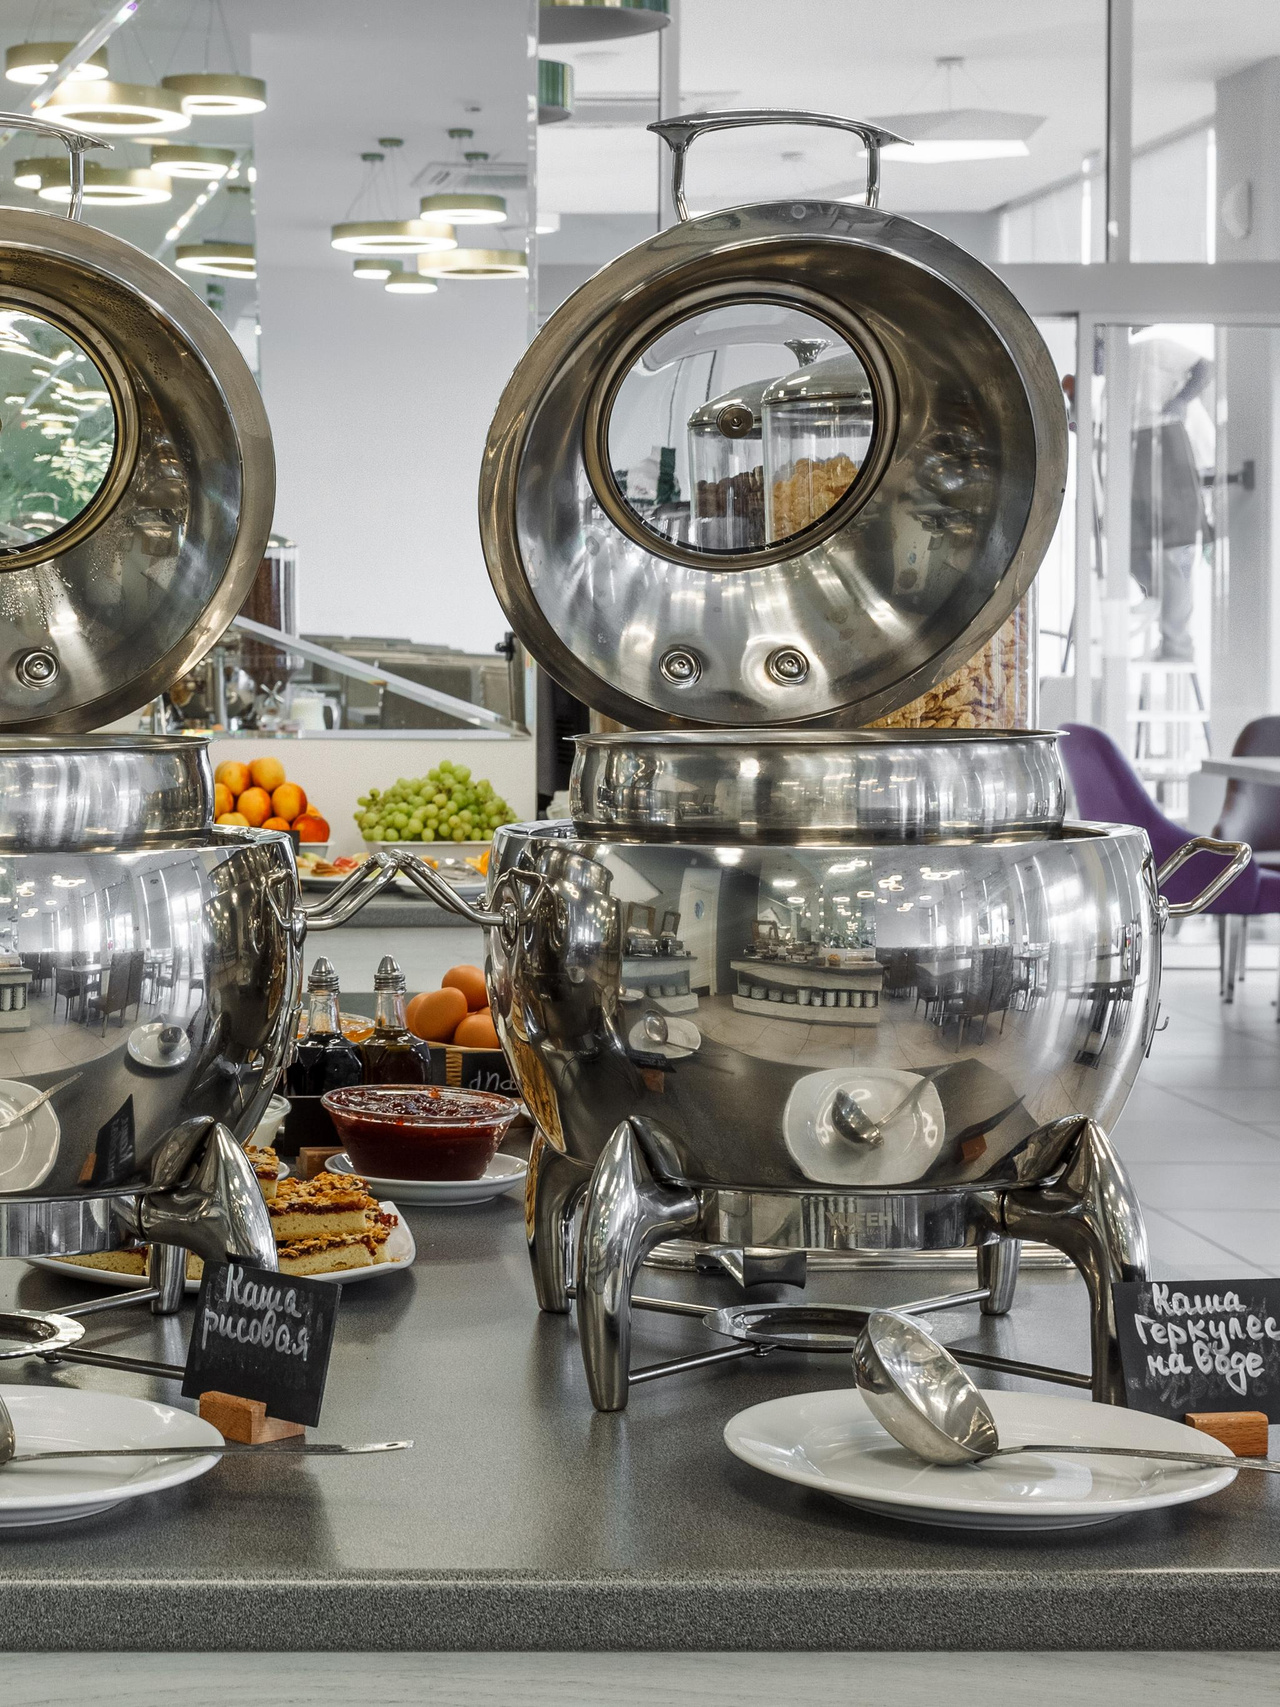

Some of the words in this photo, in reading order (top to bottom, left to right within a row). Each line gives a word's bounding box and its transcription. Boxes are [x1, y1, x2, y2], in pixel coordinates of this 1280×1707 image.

[225, 1263, 302, 1318] Каша
[1151, 1282, 1248, 1317] Каша
[1133, 1313, 1280, 1356] Геркулес
[1146, 1352, 1194, 1377] на
